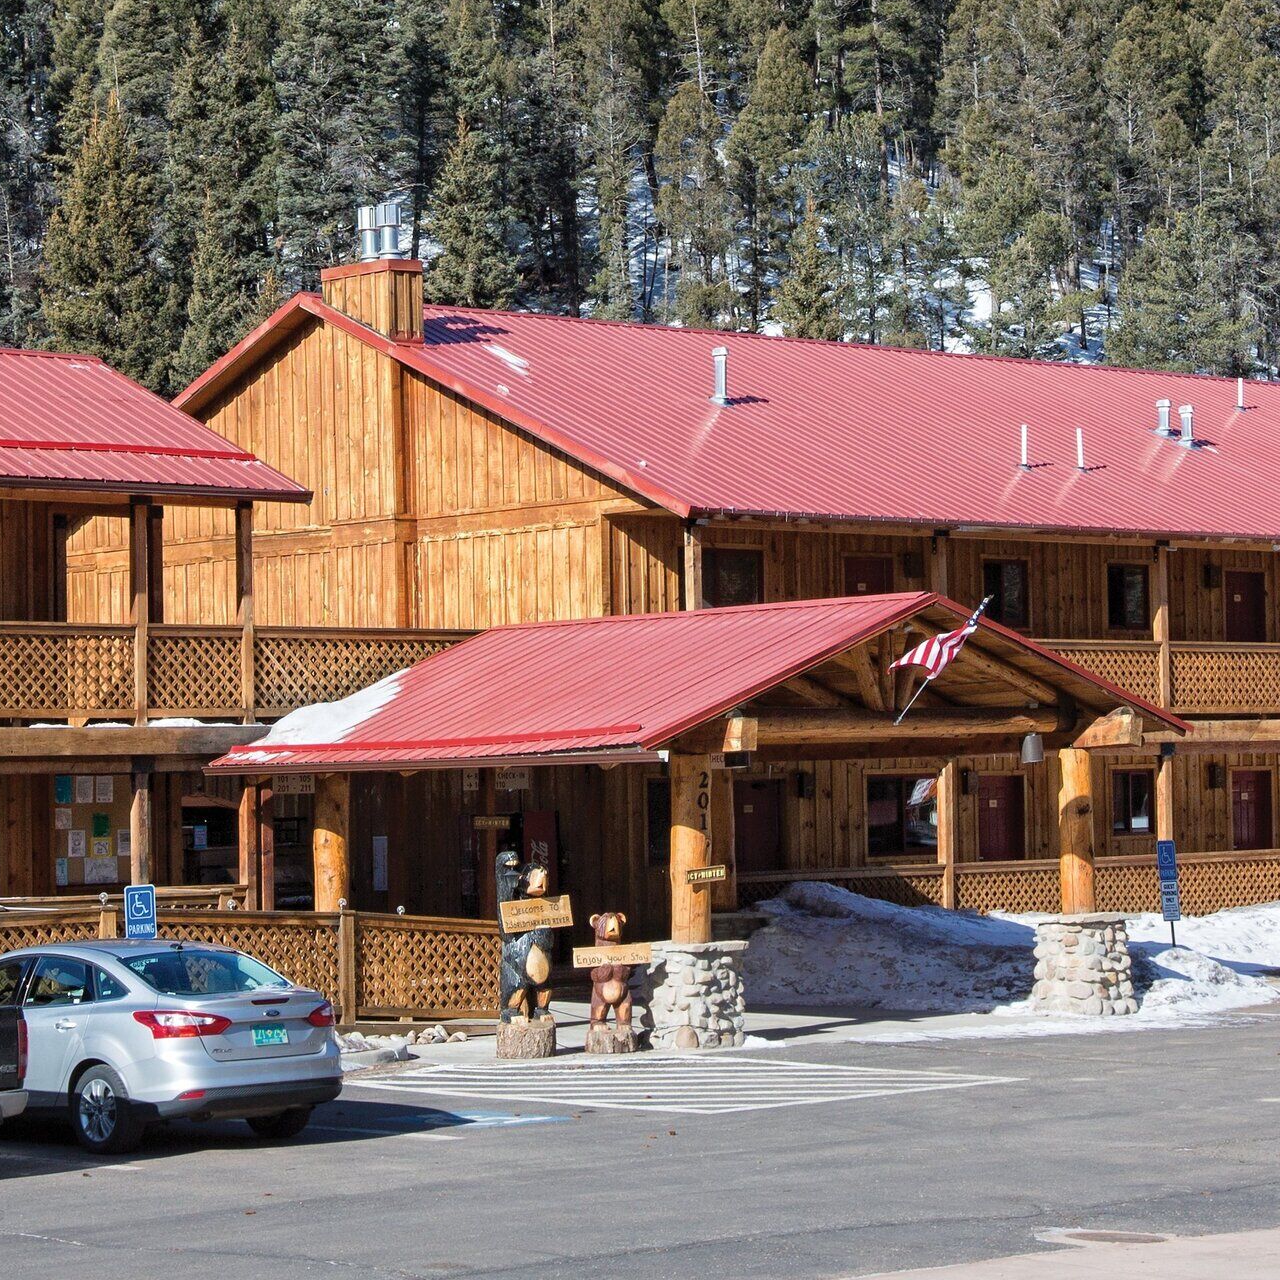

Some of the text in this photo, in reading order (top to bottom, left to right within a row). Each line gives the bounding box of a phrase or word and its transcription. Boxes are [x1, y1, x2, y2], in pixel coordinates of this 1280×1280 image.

[549, 903, 559, 912] TO
[128, 923, 155, 935] PARKING
[576, 954, 602, 965] Enjoy
